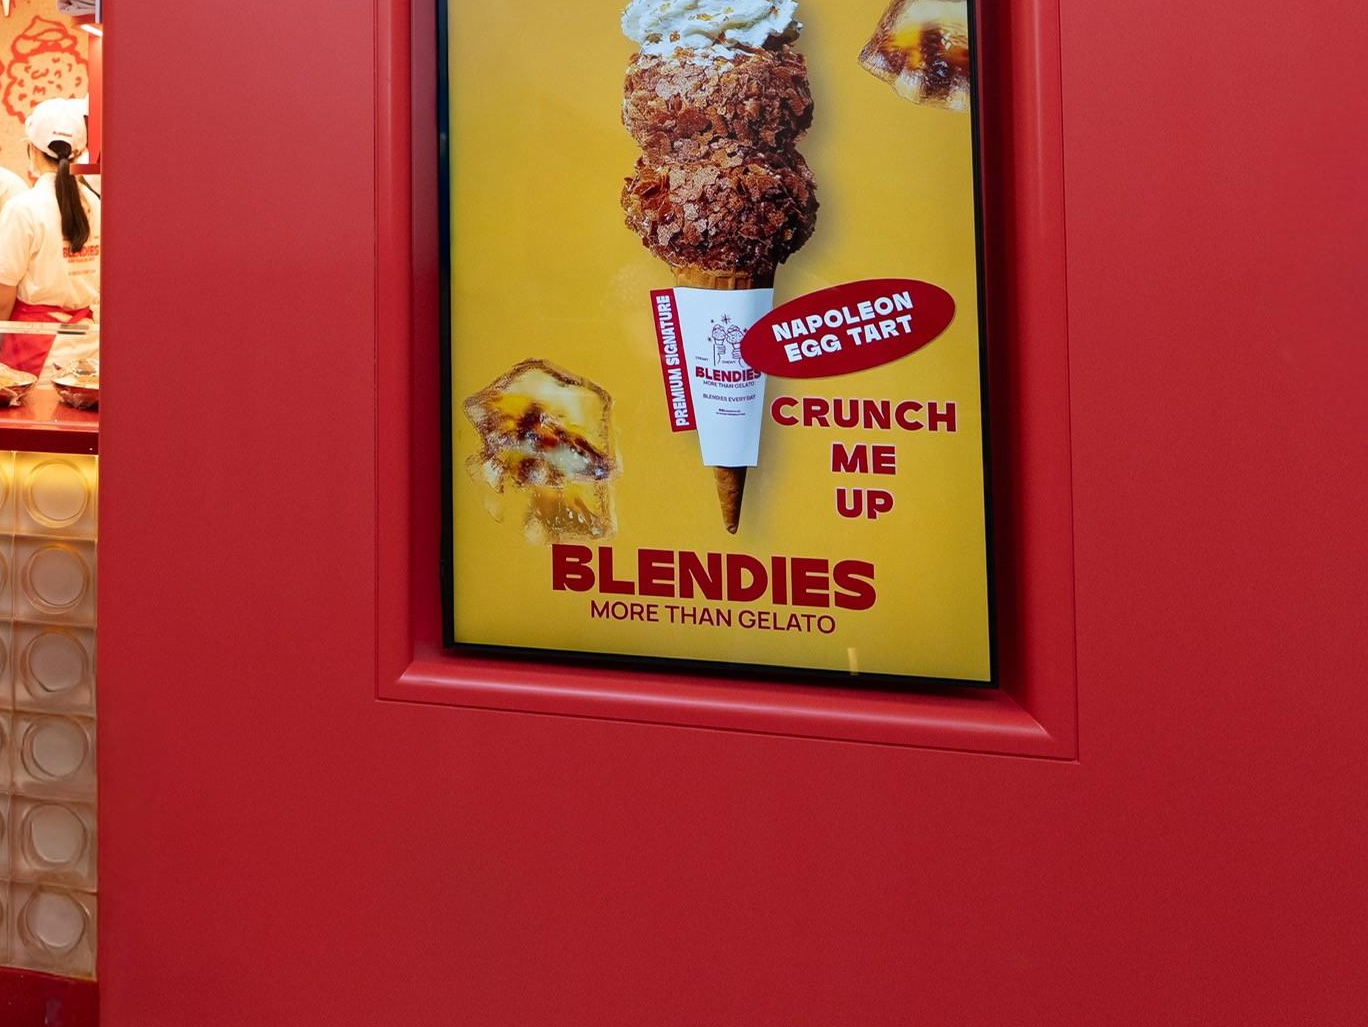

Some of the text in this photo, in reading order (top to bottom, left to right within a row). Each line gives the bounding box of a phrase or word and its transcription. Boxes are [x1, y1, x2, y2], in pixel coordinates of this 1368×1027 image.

[771, 290, 914, 342] NAPOLEON
[783, 314, 914, 363] EGG TART
[655, 295, 690, 427] PREMIUM SIGNATURE
[695, 366, 762, 383] BLENDIES
[734, 381, 755, 389] GELATO
[770, 396, 958, 433] CRUNCH
[831, 444, 897, 475] ME
[836, 488, 894, 520] UP
[551, 543, 877, 611] BLENDIES
[590, 599, 836, 634] MORE THAN GELATO
